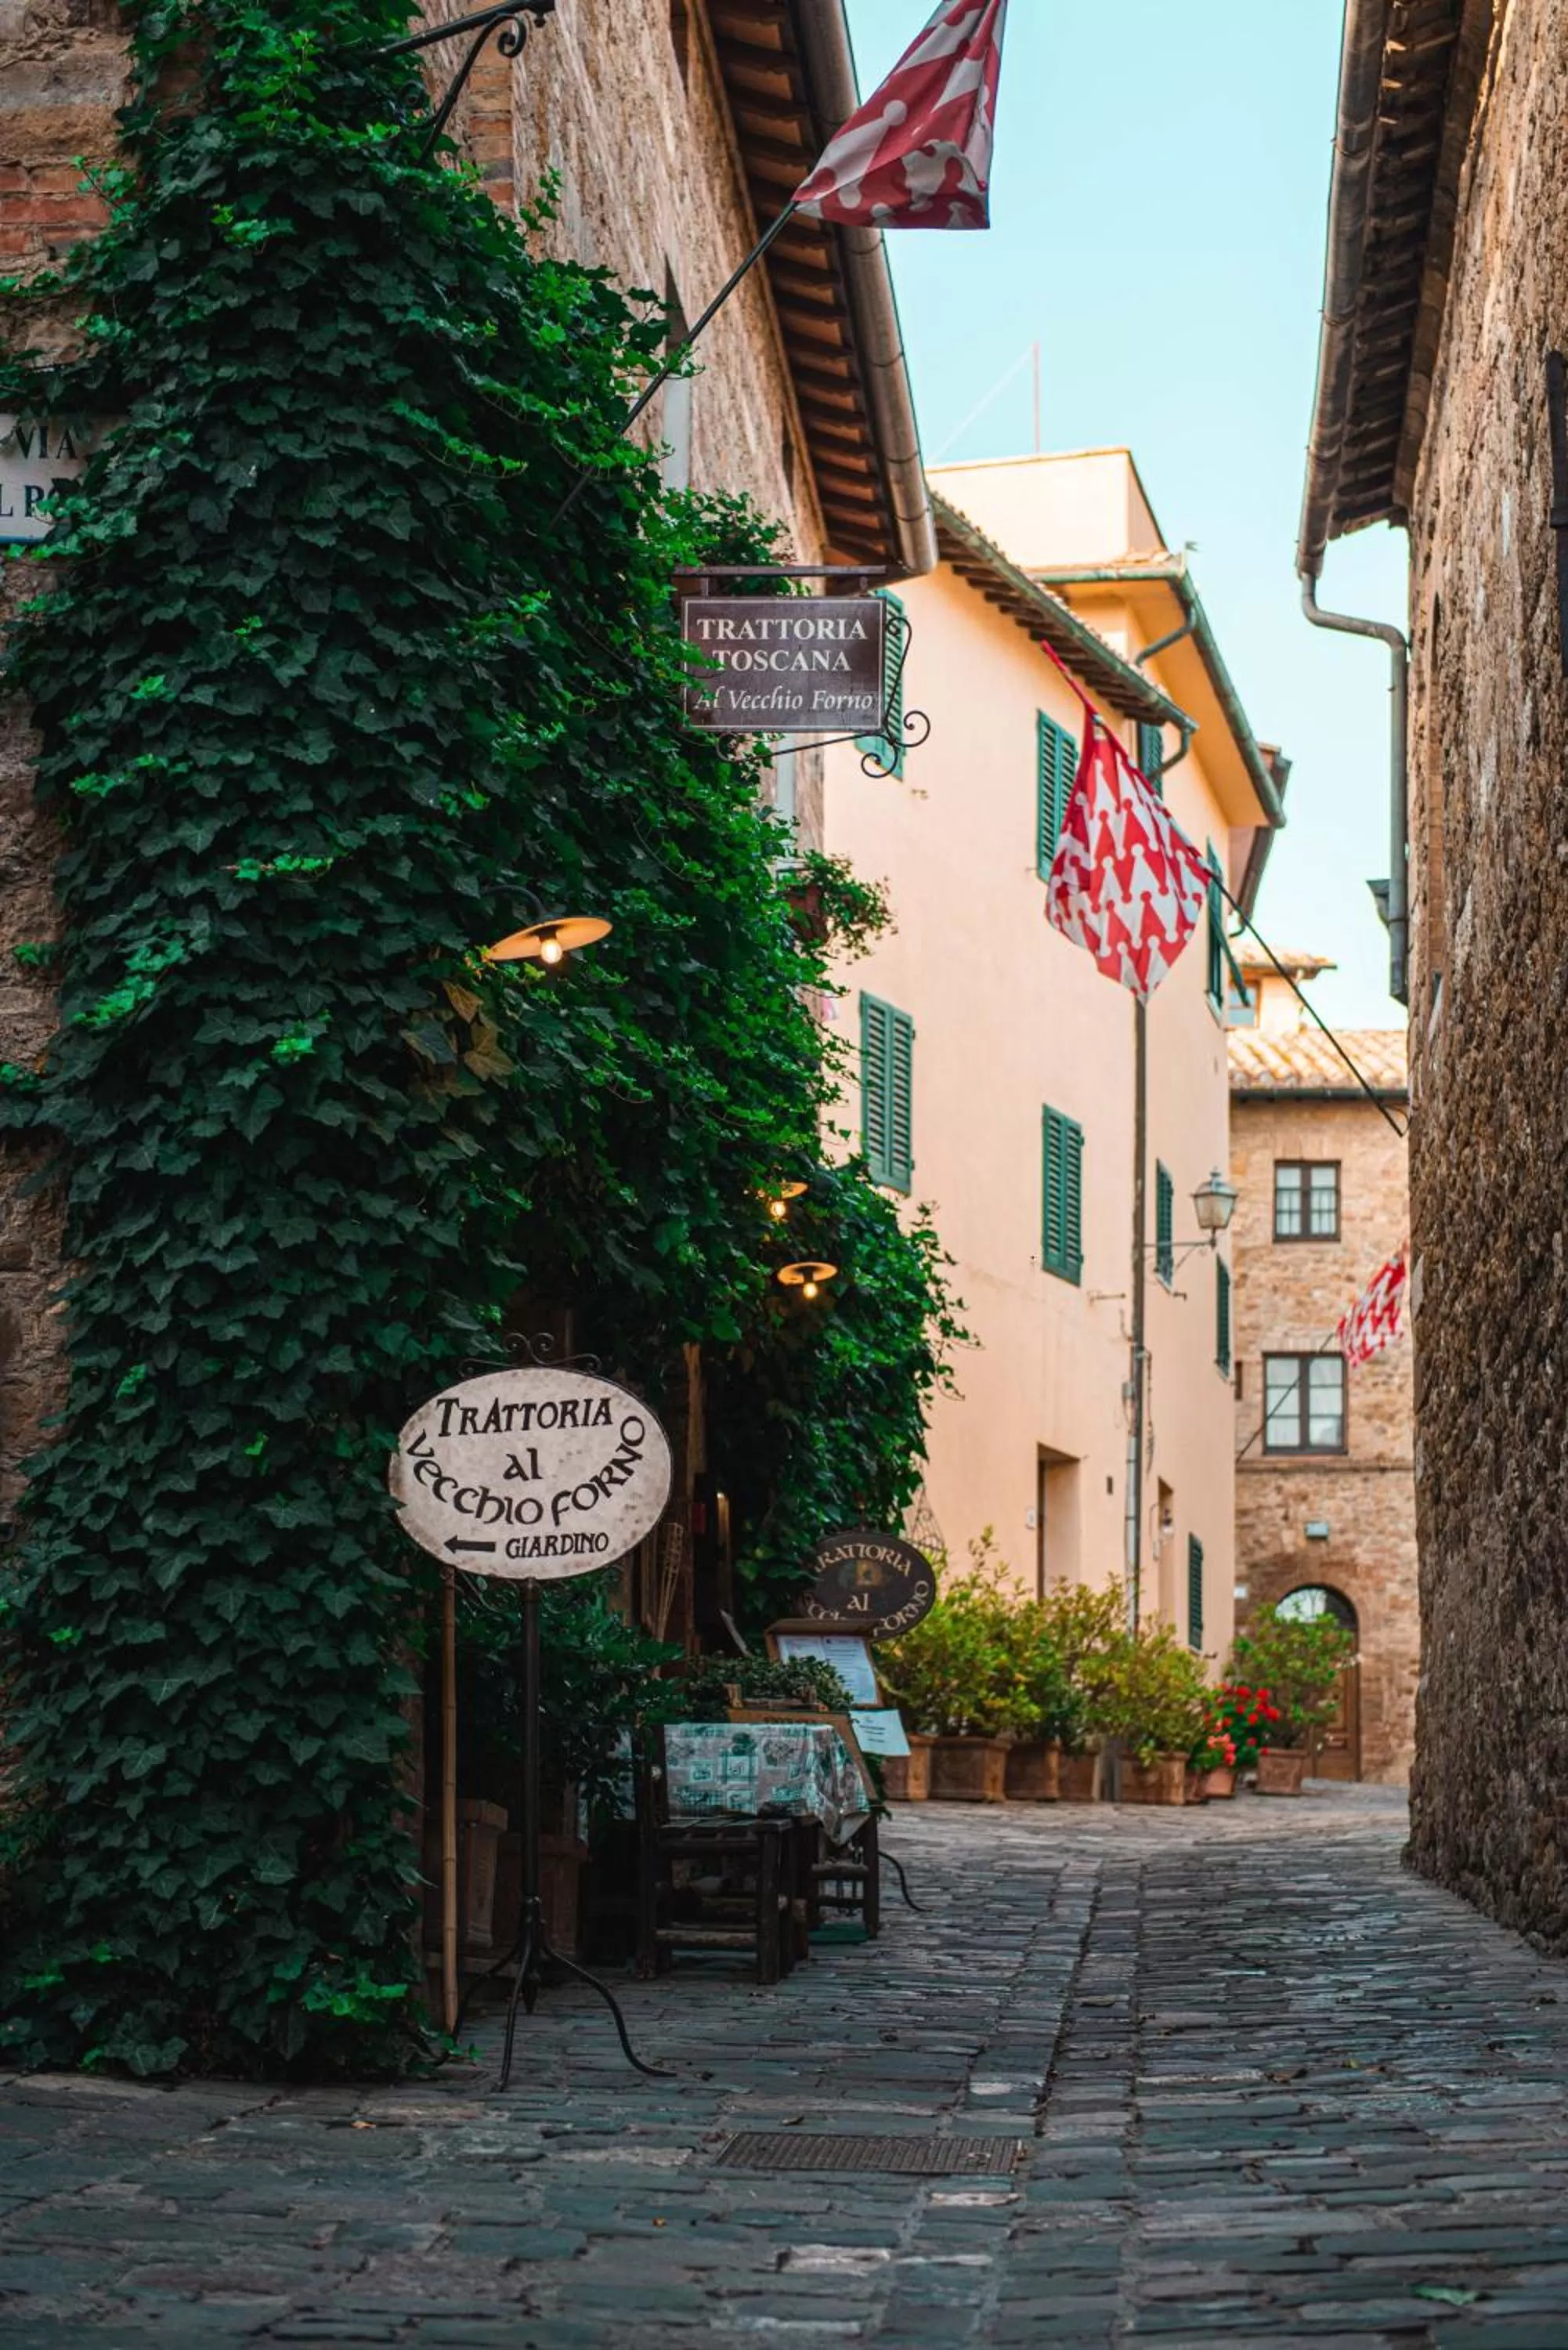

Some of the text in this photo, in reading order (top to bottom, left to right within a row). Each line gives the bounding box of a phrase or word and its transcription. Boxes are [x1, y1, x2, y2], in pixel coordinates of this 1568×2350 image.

[14, 425, 78, 459] VIA
[696, 618, 868, 640] TRATTORIA
[712, 649, 852, 671] TOSCANA
[693, 685, 873, 710] Al Vecchio Forno
[435, 1397, 614, 1437] TRATTORIA
[551, 1415, 646, 1528] FORNO
[504, 1531, 609, 1559] GIARDINO
